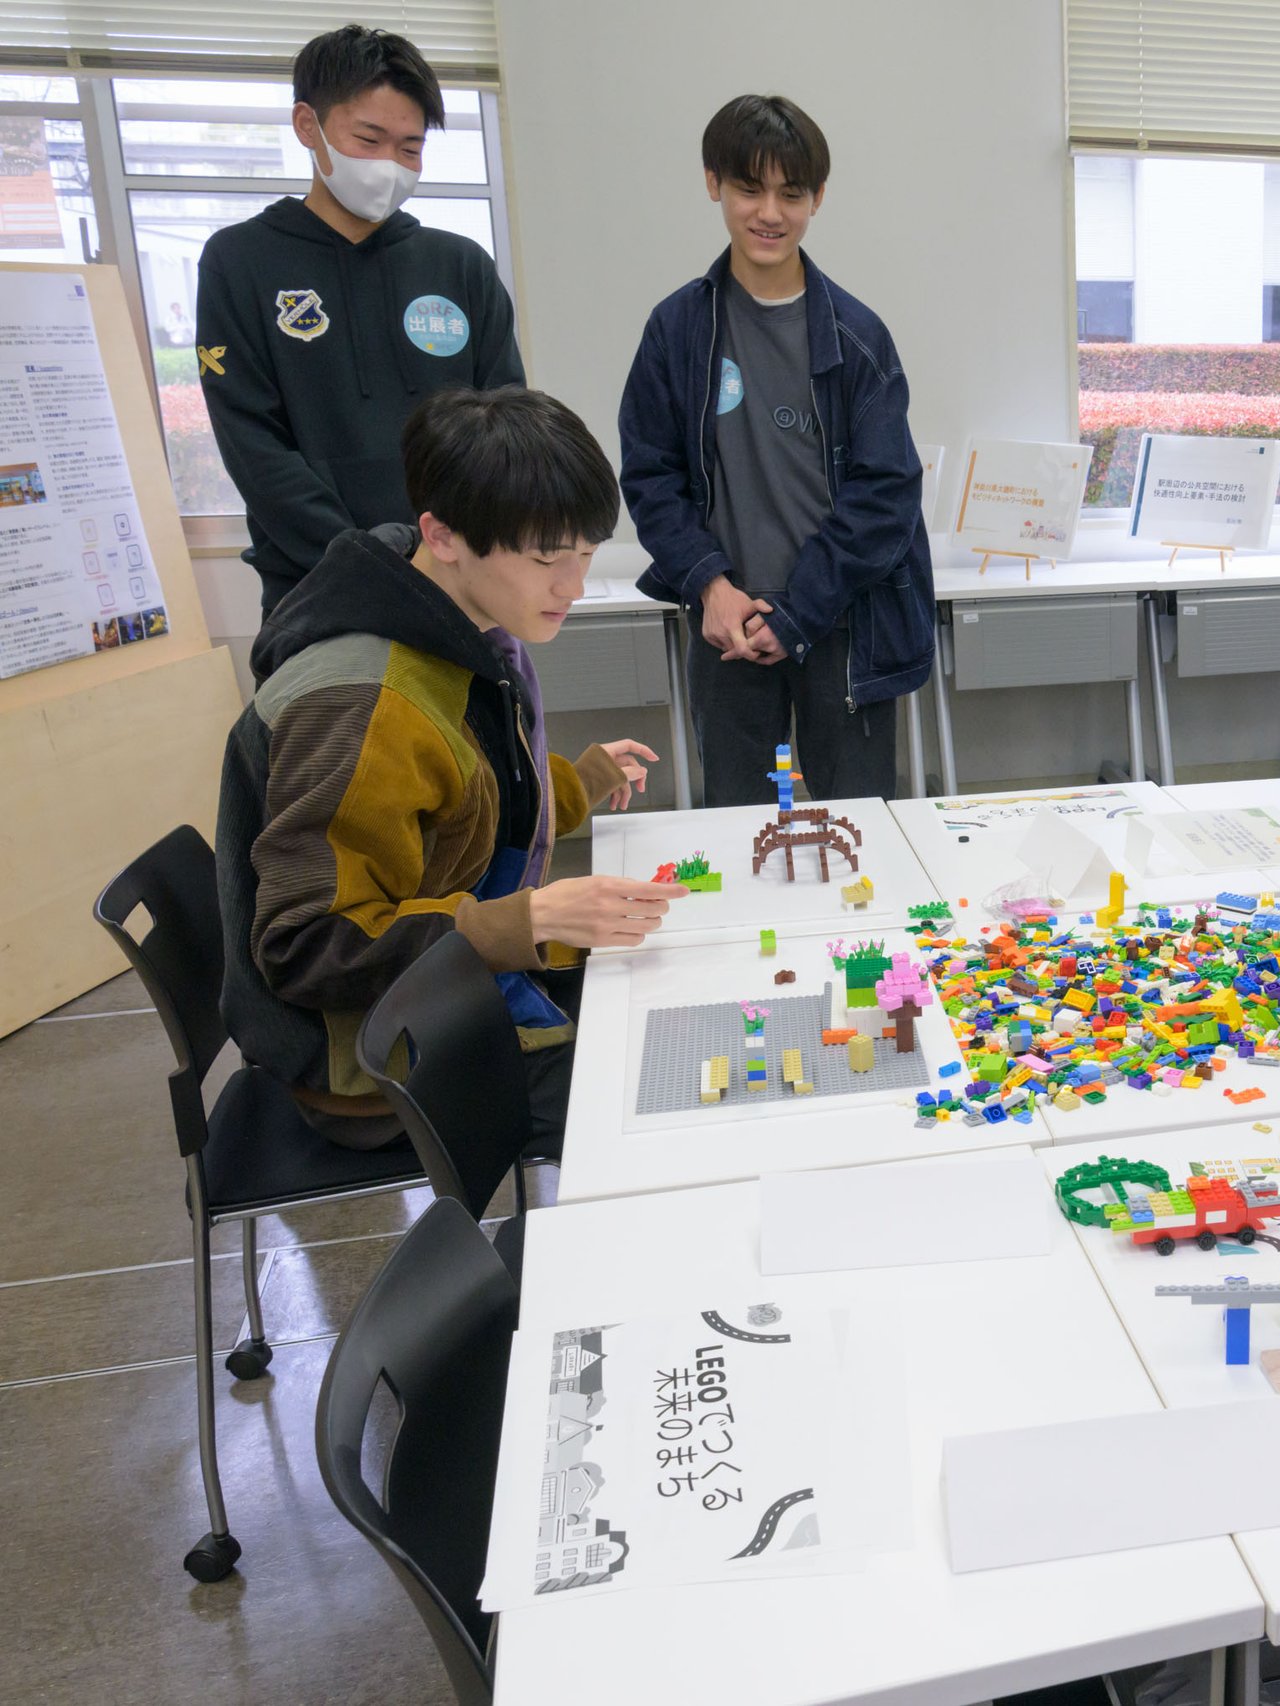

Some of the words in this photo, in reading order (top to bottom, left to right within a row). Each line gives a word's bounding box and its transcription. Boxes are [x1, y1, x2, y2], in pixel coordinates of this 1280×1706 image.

[416, 302, 454, 316] ORF
[409, 316, 464, 335] 出展者
[1158, 478, 1245, 492] 駅周辺の公共空間における
[653, 1367, 699, 1498] 未来のまち
[695, 1344, 743, 1511] LEGOでつくる
